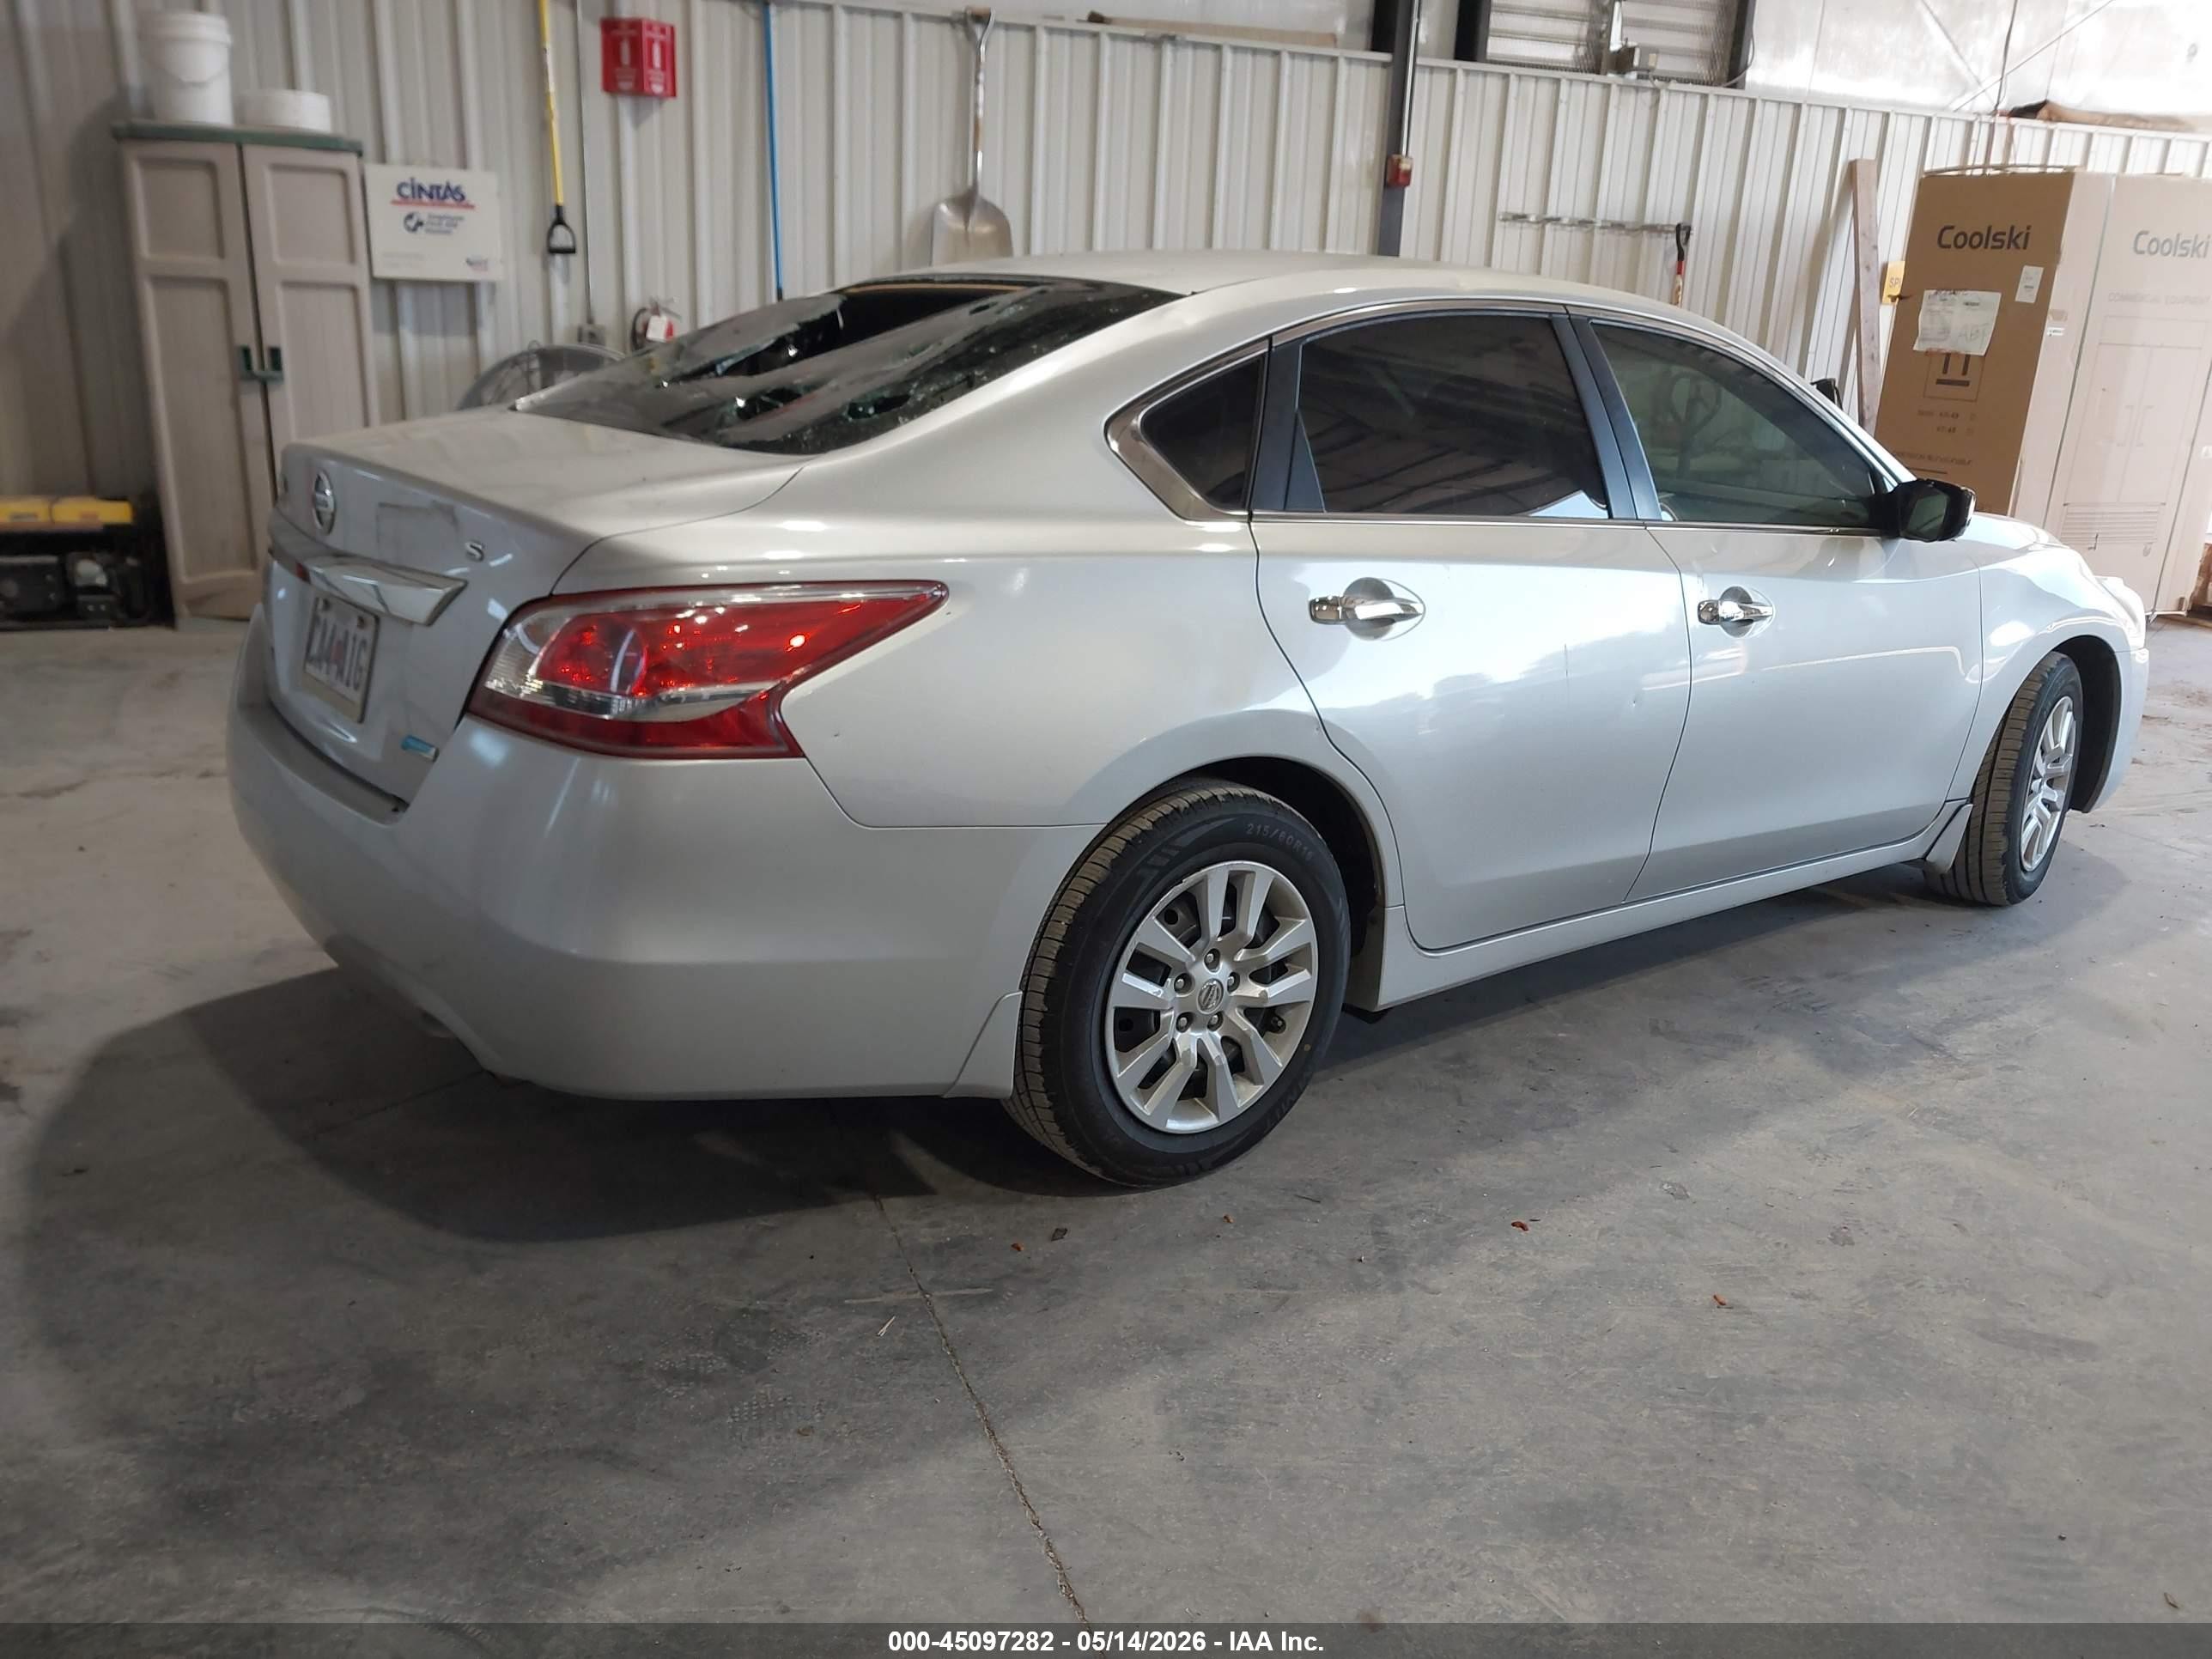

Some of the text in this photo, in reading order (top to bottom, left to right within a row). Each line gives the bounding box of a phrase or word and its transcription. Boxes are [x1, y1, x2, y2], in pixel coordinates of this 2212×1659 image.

[1937, 225, 2032, 251] Coolski
[2133, 230, 2211, 258] Coolski
[465, 540, 485, 562] S
